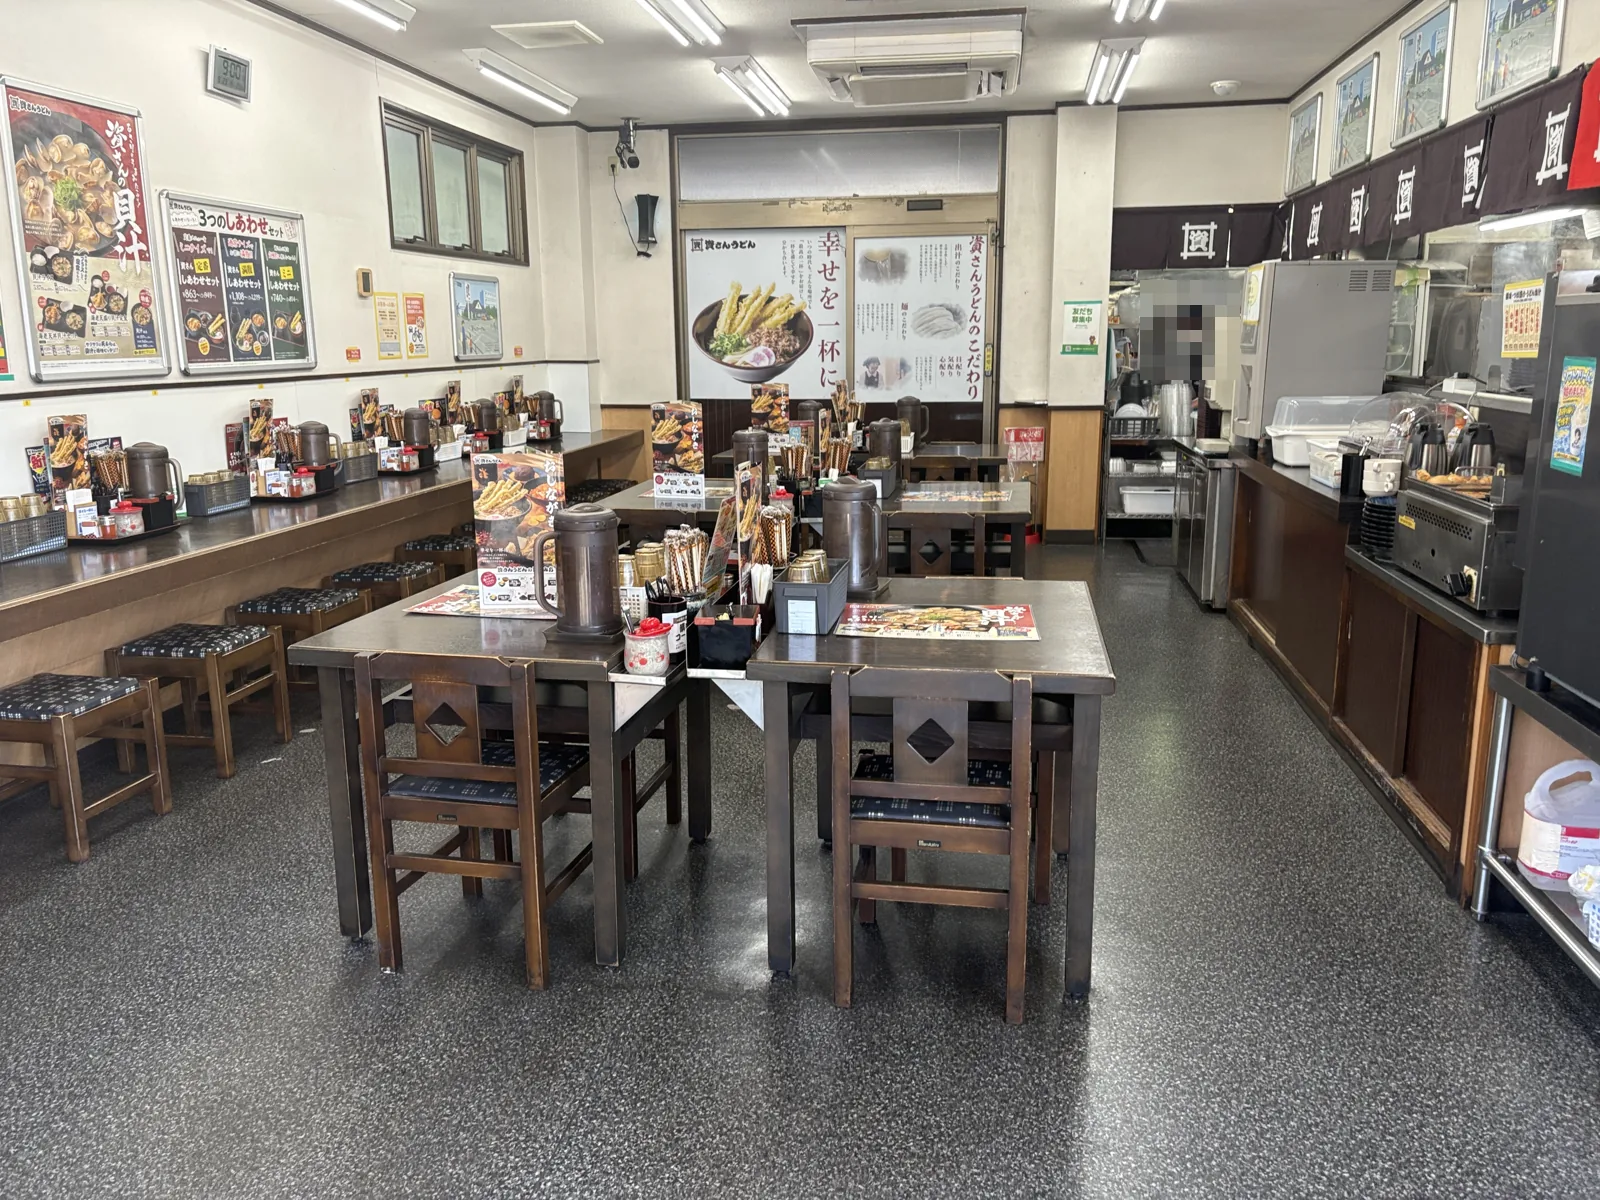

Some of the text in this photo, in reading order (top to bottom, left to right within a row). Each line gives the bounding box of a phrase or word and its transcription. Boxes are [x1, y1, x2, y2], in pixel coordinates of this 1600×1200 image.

[198, 209, 284, 238] 3つのしあわせセット
[704, 239, 756, 251] 資さんうどん
[954, 243, 963, 291] 出汁のこだわり
[181, 274, 220, 288] しあわせセット
[228, 277, 262, 290] しあわせセット
[269, 281, 300, 293] しあわせセット
[818, 231, 841, 388] 幸せを一杯に
[966, 235, 985, 401] 資さんうどんのこだわり
[1072, 308, 1093, 316] 友だち
[939, 356, 947, 377] 心配り
[947, 356, 955, 377] 気配り
